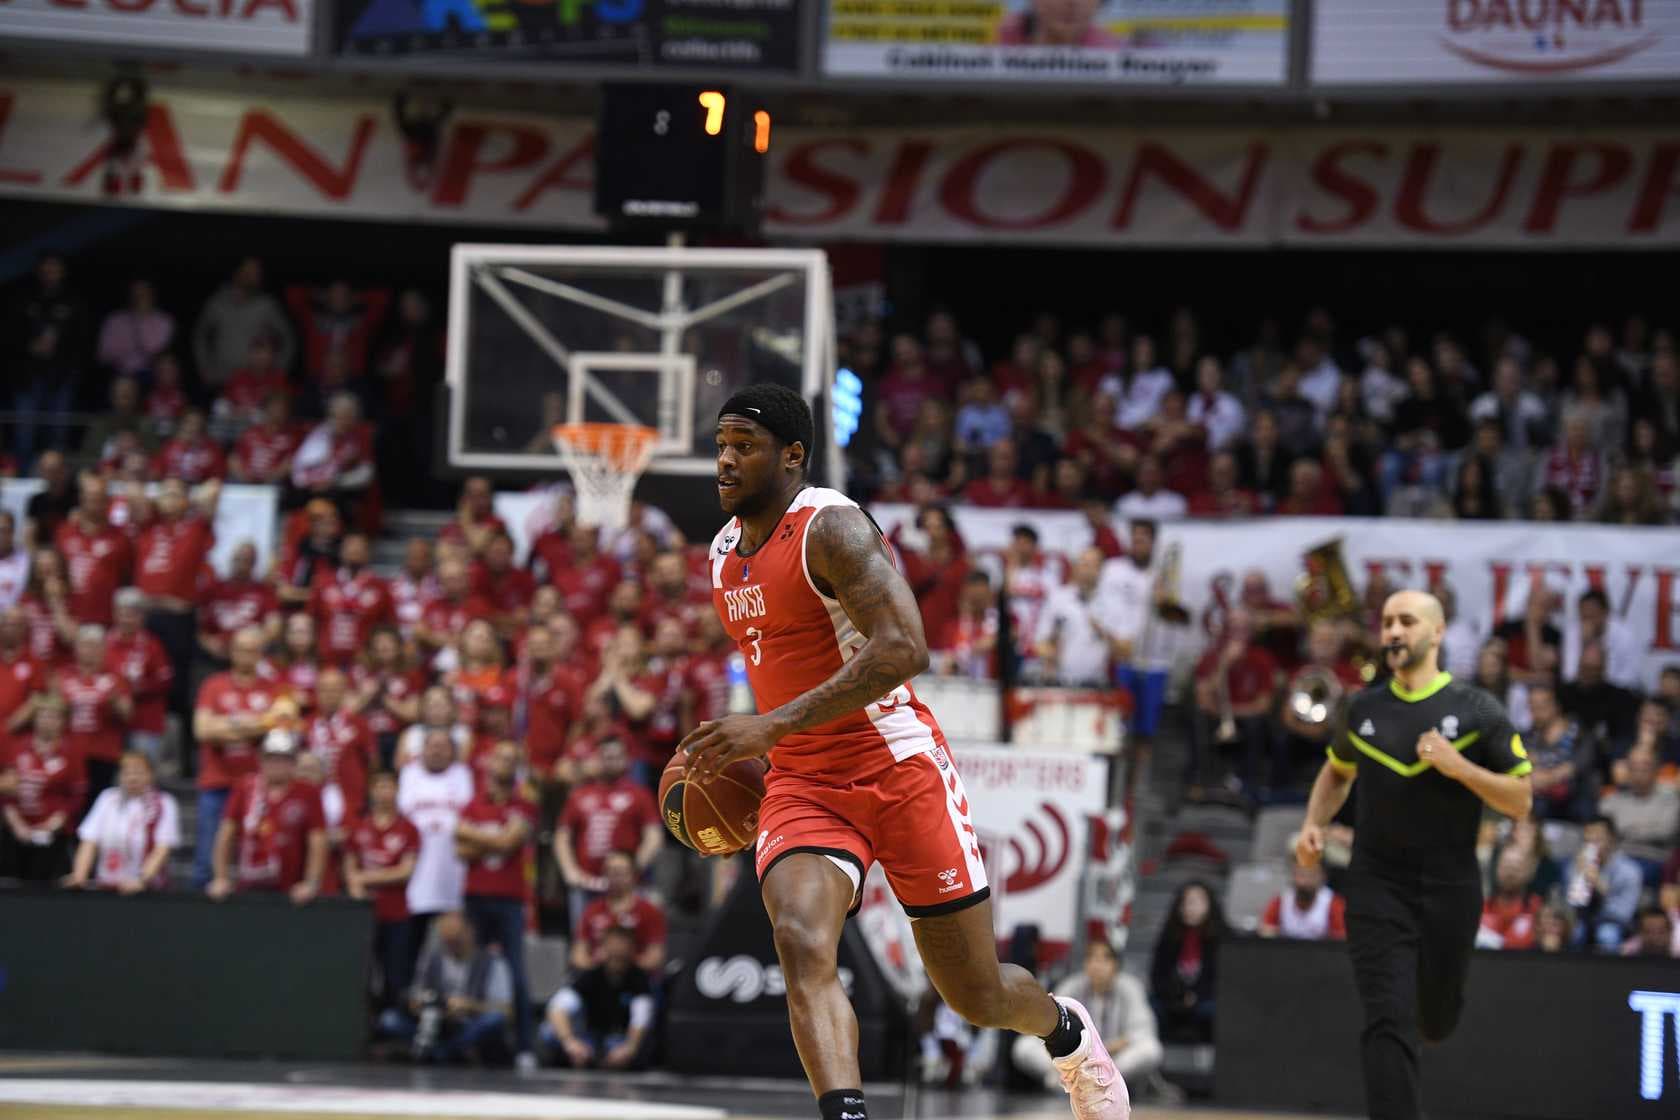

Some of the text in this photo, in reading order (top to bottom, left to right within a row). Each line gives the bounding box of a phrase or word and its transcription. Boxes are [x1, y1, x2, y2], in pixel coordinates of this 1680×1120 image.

[724, 584, 767, 622] AMSB
[746, 626, 762, 666] 3
[938, 881, 964, 894] hummel
